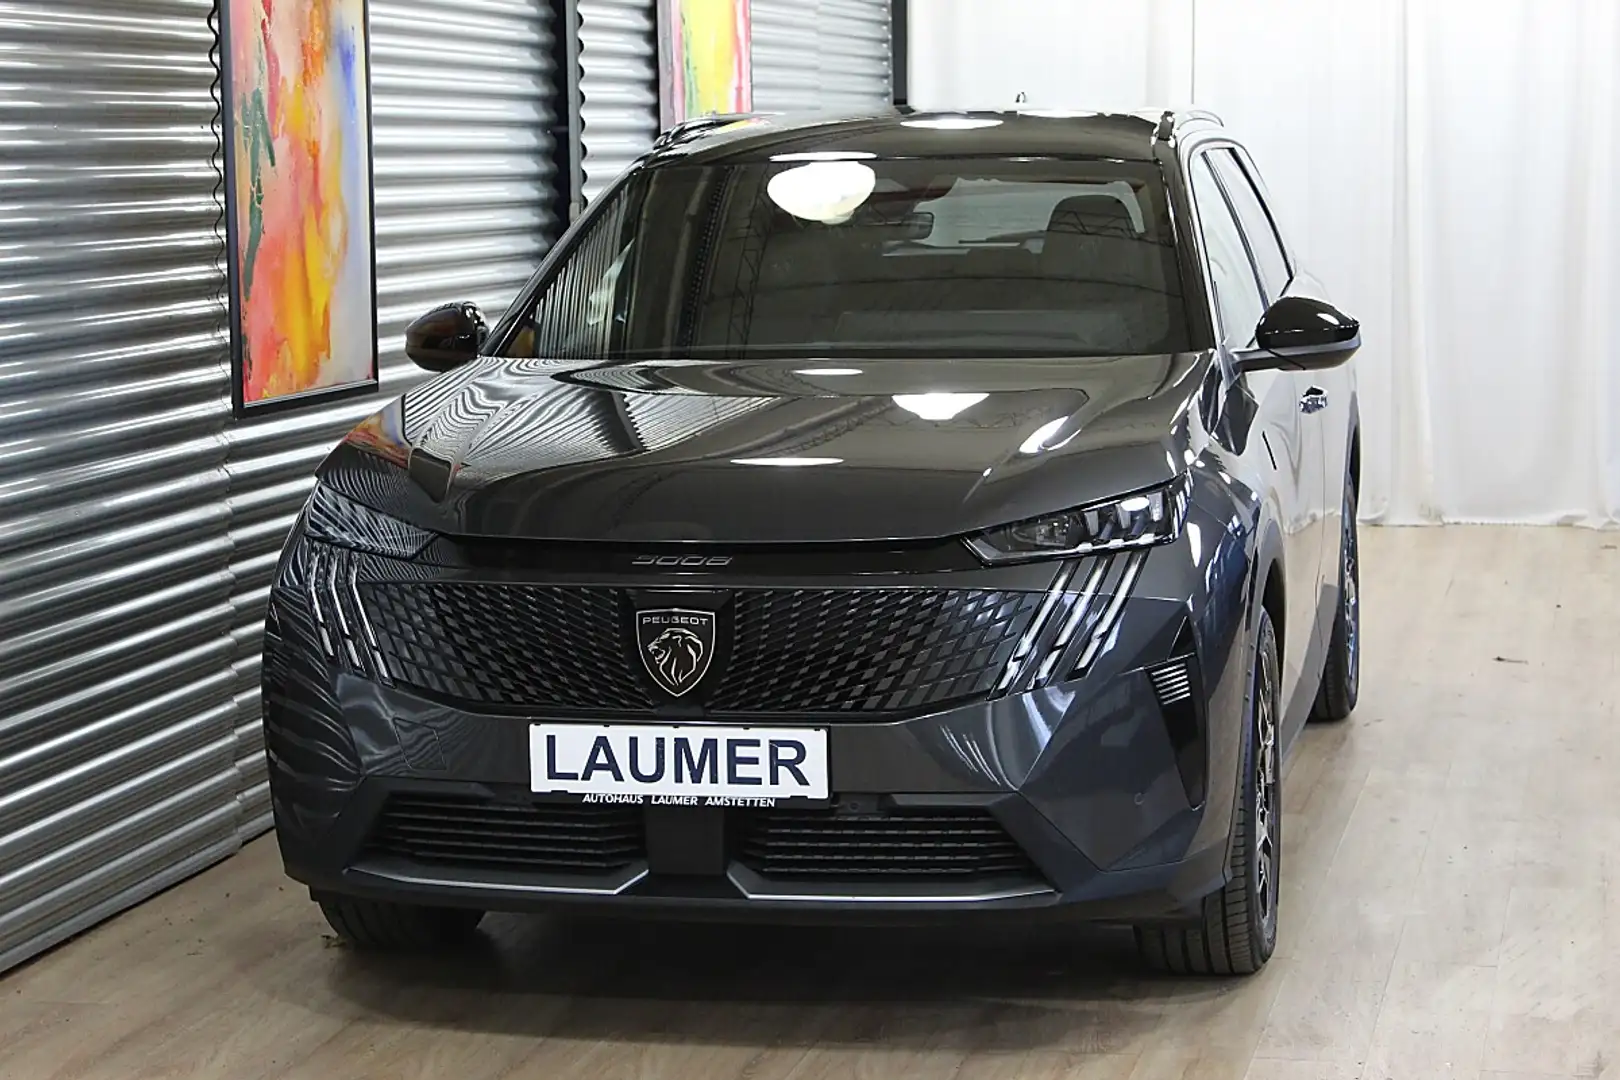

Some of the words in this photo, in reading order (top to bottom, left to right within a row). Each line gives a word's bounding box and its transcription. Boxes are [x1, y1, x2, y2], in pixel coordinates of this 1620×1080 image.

[642, 615, 709, 626] PEUGEOT
[545, 734, 811, 787] LAUMER
[582, 793, 644, 804] AUTOHAUS
[650, 794, 698, 806] LAUMER
[704, 796, 776, 808] AMSTETTEN
